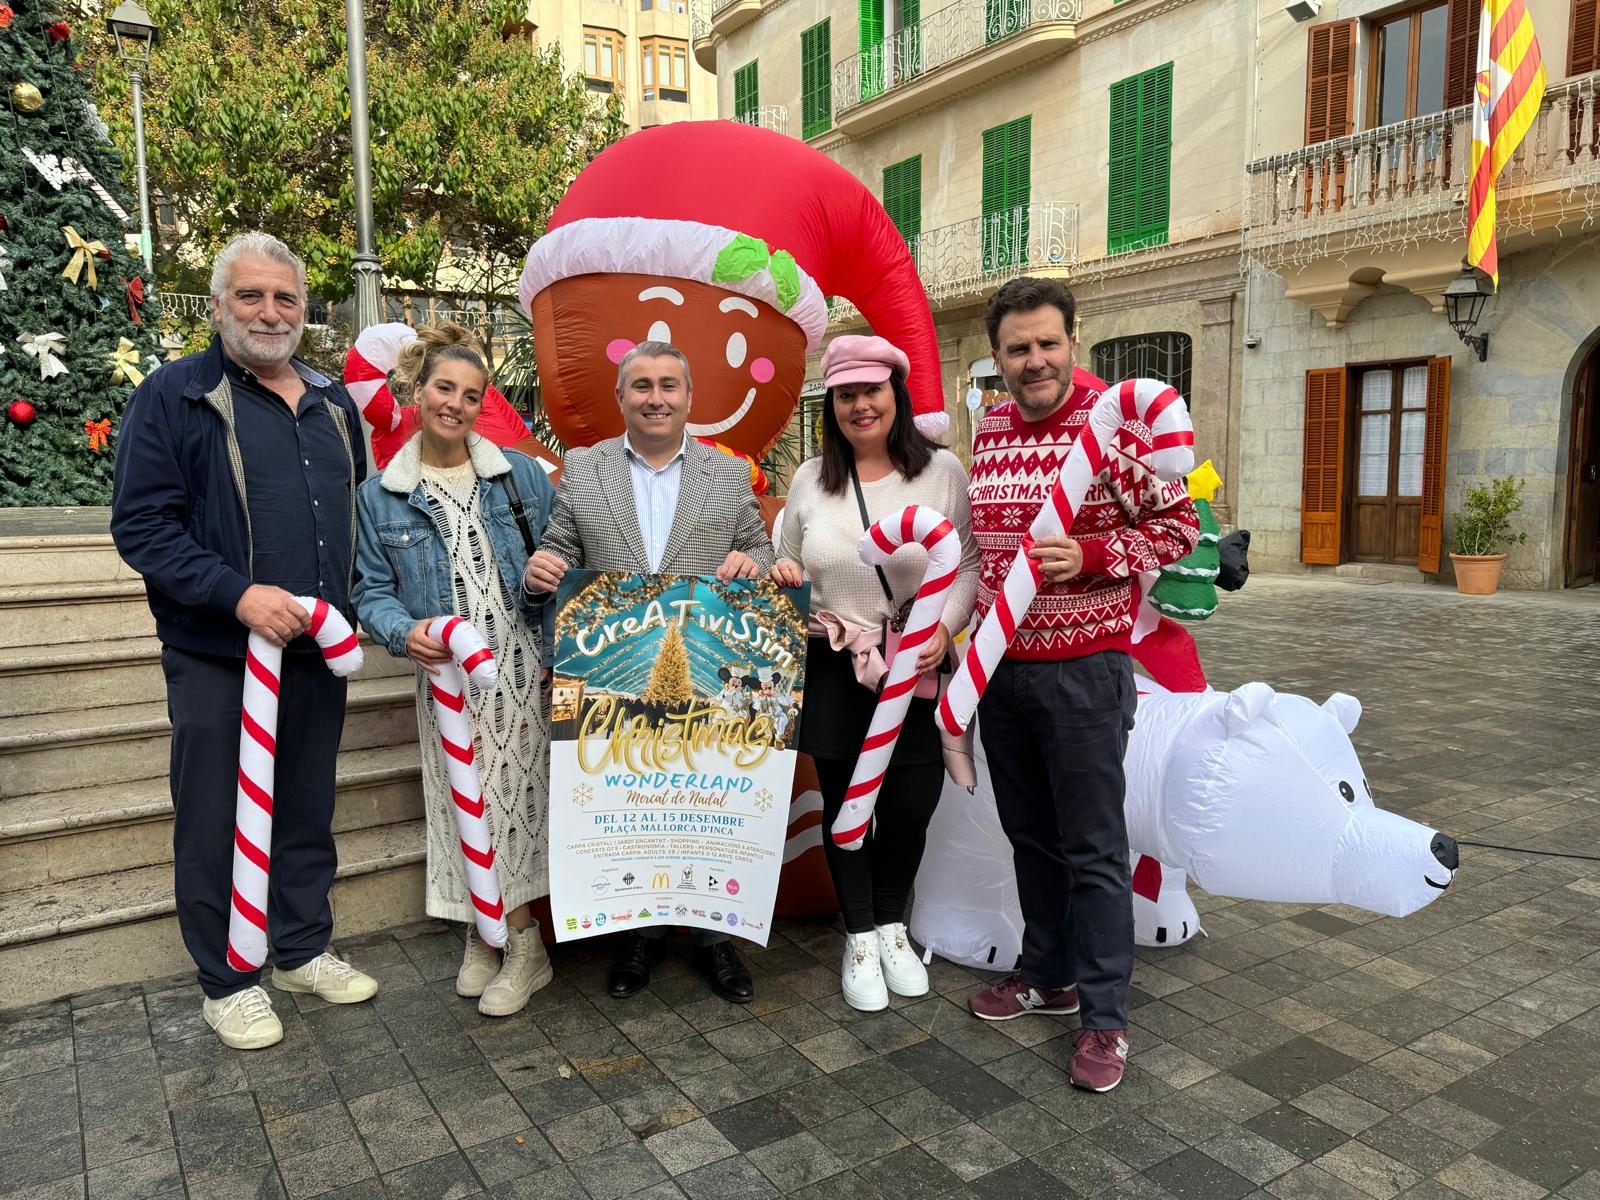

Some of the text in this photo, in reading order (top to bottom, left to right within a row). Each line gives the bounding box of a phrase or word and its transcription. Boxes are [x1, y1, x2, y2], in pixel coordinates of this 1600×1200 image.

[971, 483, 1054, 502] CHRISTMAS
[577, 695, 773, 775] Christmas
[604, 771, 754, 794] WONDERLAND
[626, 789, 728, 808] Mercat de Nadal
[594, 812, 745, 828] DEL 12 AL 15 DESEMBRE
[604, 823, 734, 836] PLAÇA MALLORCA D'INCA
[670, 838, 700, 846] SHOPPING
[575, 847, 606, 855] CONCERTS
[593, 852, 620, 860] ENTRADA
